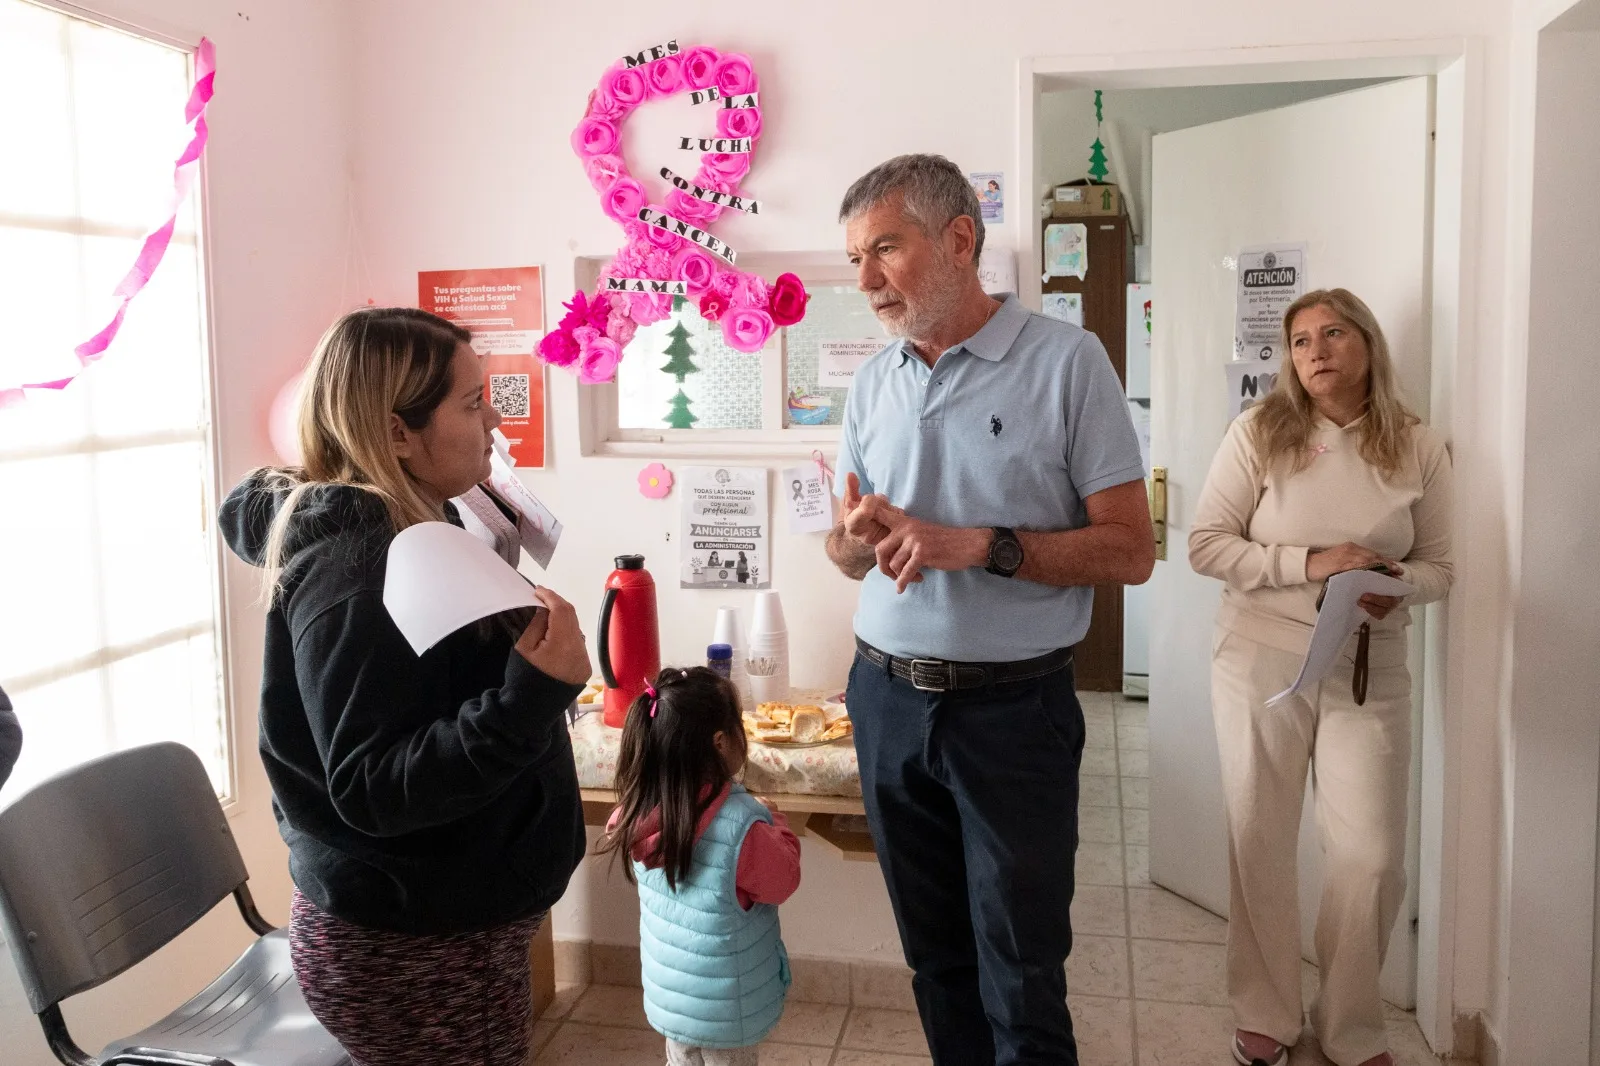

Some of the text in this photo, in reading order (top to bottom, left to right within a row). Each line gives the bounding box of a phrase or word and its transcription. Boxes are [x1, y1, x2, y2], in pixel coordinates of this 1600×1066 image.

[623, 39, 679, 69] MES
[689, 87, 758, 109] DE LA
[678, 137, 751, 152] LUCHA
[660, 167, 759, 214] CONTRA
[639, 208, 734, 263] CANCER
[1246, 268, 1294, 285] ATENCIÓN
[434, 284, 521, 295] Tus preguntas sobre
[608, 278, 685, 294] MAMA
[434, 295, 450, 303] VIH
[486, 293, 517, 301] Sexual
[445, 304, 489, 312] contestan
[490, 301, 507, 311] acá
[694, 487, 713, 495] TODAS
[702, 506, 748, 516] profesional
[695, 526, 758, 537] ANUNCIARSE
[704, 542, 754, 550] ADMINISTRACIÓN
